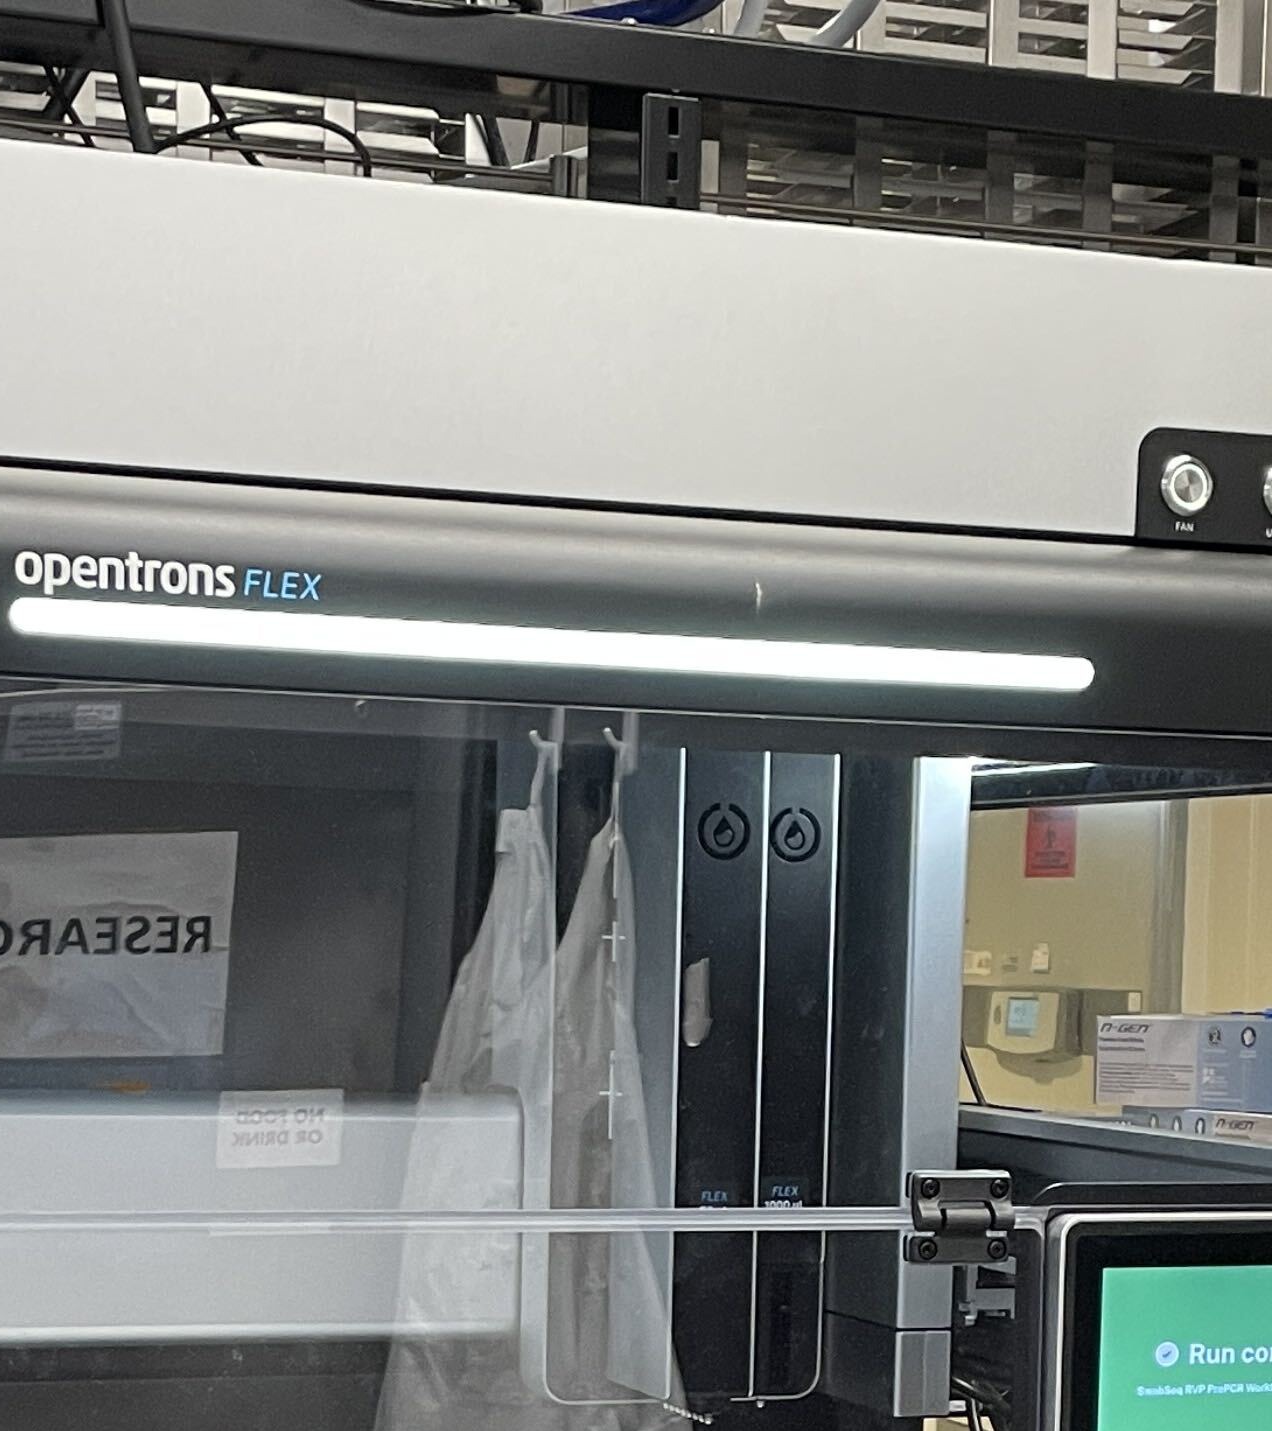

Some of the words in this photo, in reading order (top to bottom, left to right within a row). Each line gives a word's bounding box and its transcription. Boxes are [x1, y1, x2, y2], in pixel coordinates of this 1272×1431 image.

[1175, 521, 1195, 532] FAN
[14, 551, 236, 598] opentrons
[243, 569, 323, 600] FLEX
[771, 1186, 799, 1197] FLEX
[1189, 1343, 1235, 1364] Run
[1185, 1385, 1206, 1394] RVP
